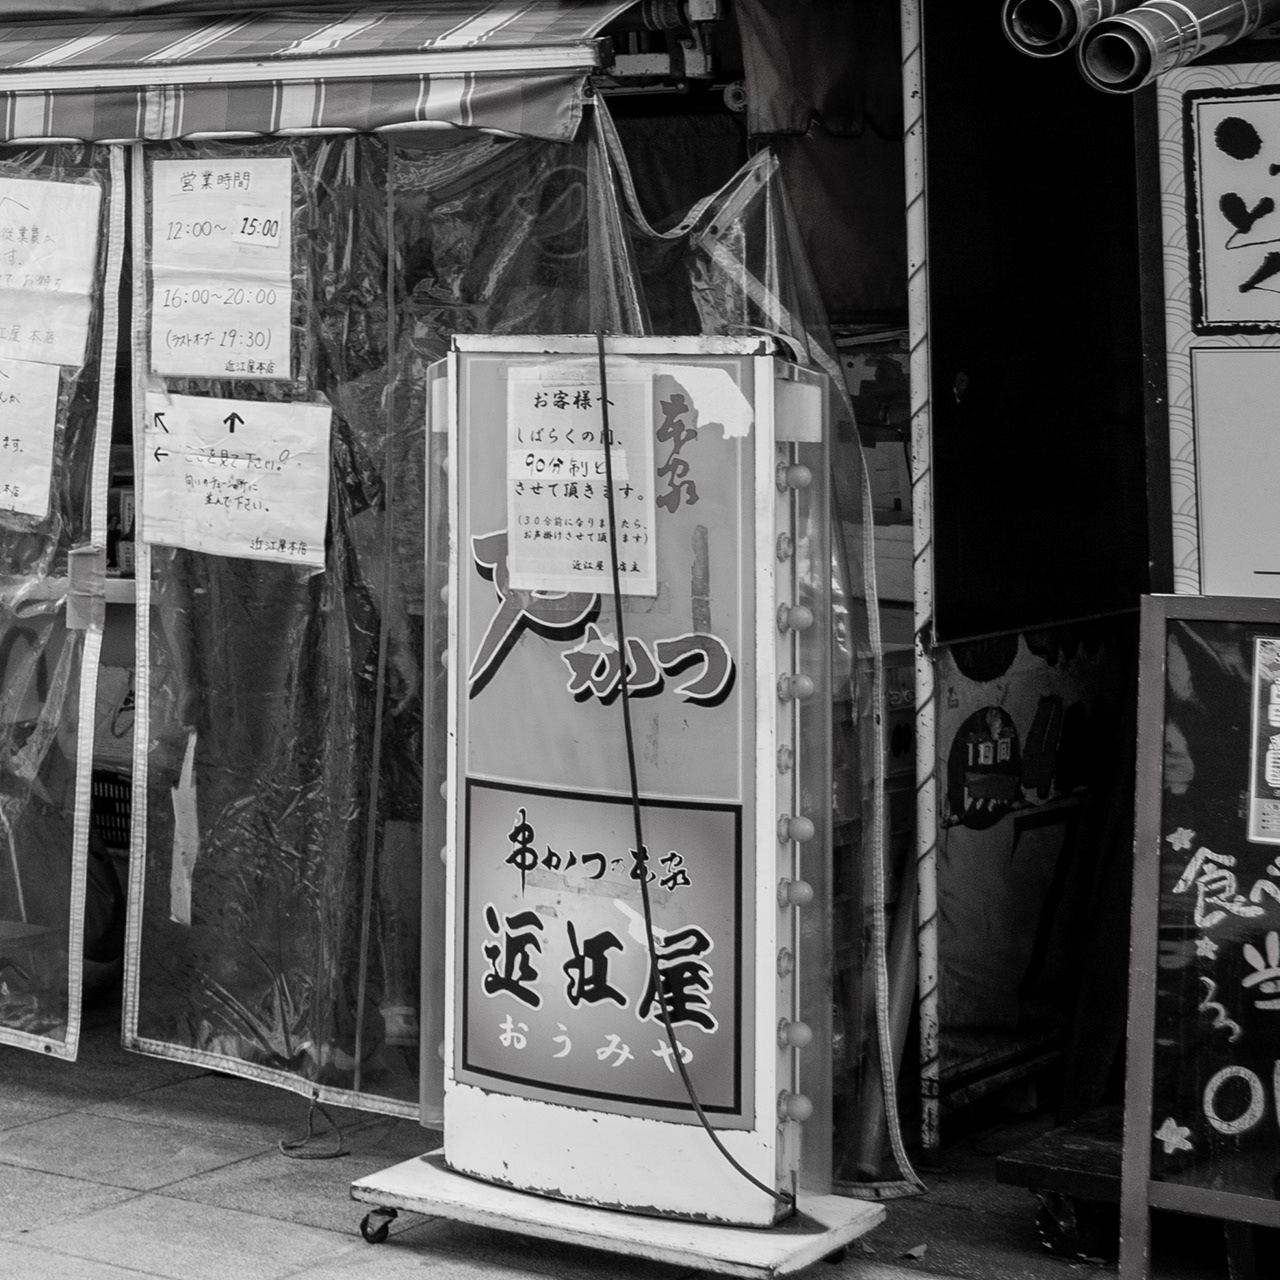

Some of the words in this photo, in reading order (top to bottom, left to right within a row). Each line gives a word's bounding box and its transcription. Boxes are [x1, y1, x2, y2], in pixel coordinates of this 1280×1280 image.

[180, 171, 250, 192] 営業時間
[240, 217, 279, 238] 15:00
[225, 359, 275, 374] 近江屋本店
[534, 391, 614, 409] お客様へ
[518, 515, 648, 531] (30分前になりまたら、
[523, 531, 649, 545] お声掛けさせて頂ます)
[483, 904, 715, 1031] 近江屋
[500, 1015, 693, 1073] おうみや
